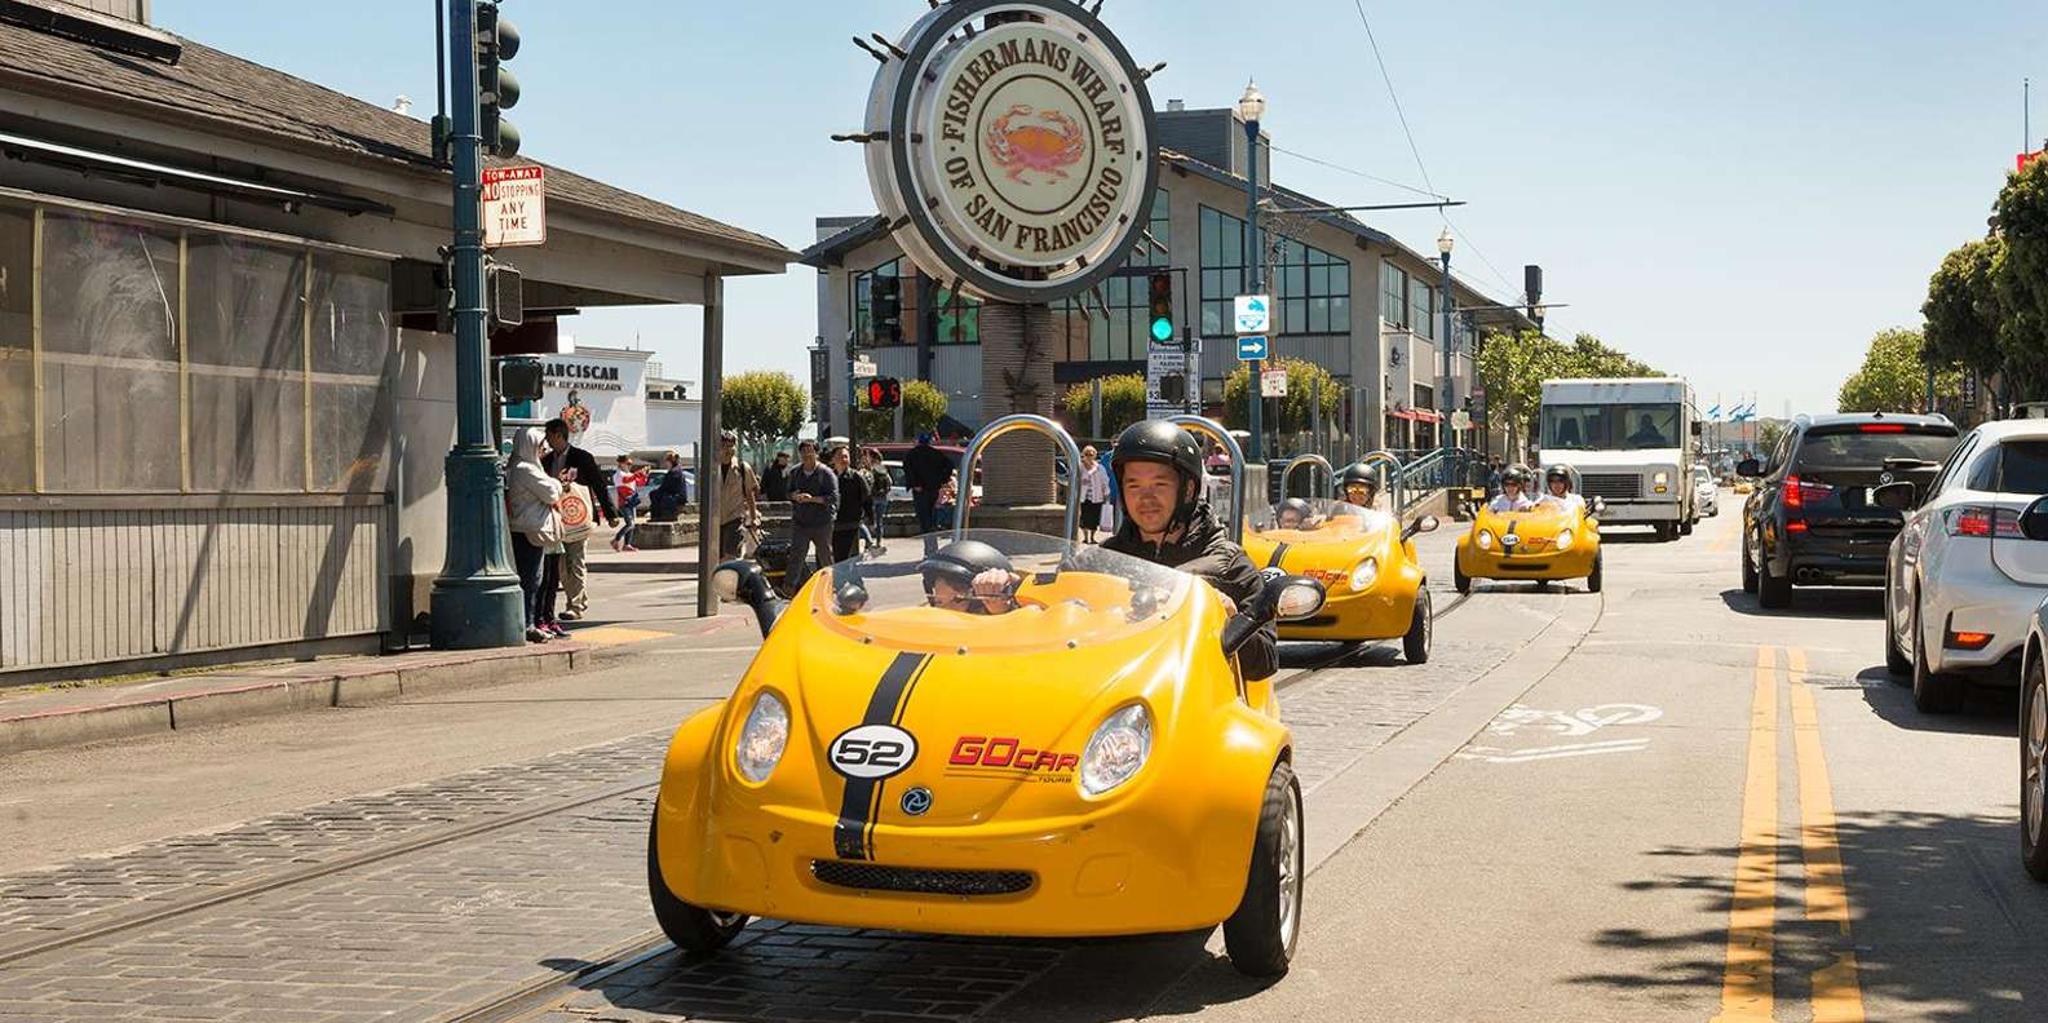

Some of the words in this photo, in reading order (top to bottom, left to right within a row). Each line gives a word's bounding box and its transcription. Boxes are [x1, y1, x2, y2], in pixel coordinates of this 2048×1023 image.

[942, 37, 1072, 143] FISHERMANS
[1072, 56, 1125, 156] WHARF
[485, 168, 538, 182] TOW-AWAY
[483, 182, 499, 200] NO
[501, 184, 539, 198] STOPPING
[501, 201, 525, 214] ANY
[945, 155, 975, 190] OF
[964, 193, 1012, 242] SAN
[1014, 166, 1123, 253] FRANCISCO
[499, 217, 528, 230] TIME
[835, 739, 905, 768] 52
